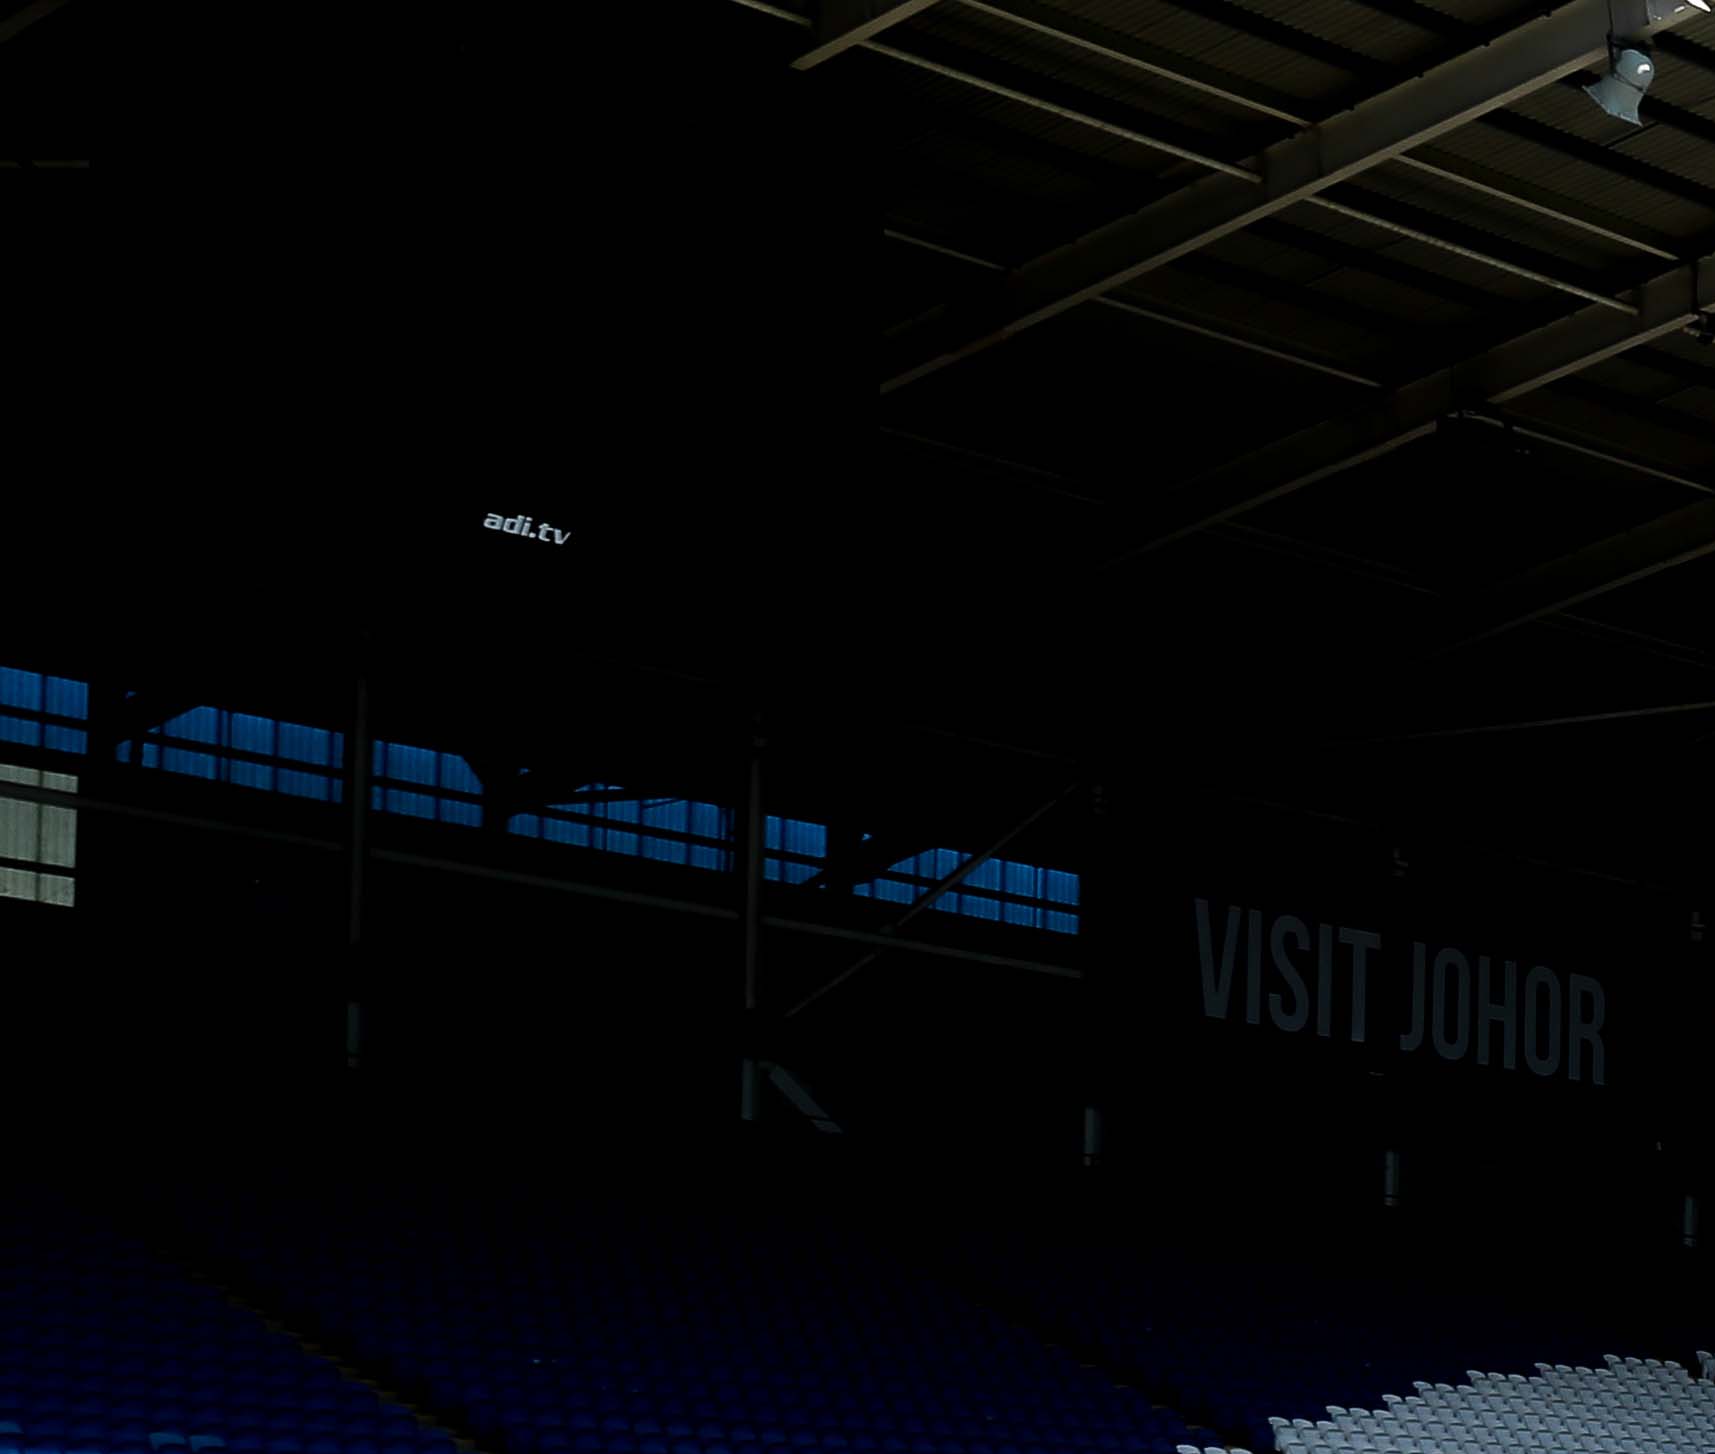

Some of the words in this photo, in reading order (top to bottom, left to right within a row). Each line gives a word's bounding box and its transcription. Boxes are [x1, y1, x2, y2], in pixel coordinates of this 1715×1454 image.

[482, 512, 572, 545] adi.tv
[1193, 896, 1383, 1045] VISIT
[1399, 938, 1611, 1087] JOHOR
